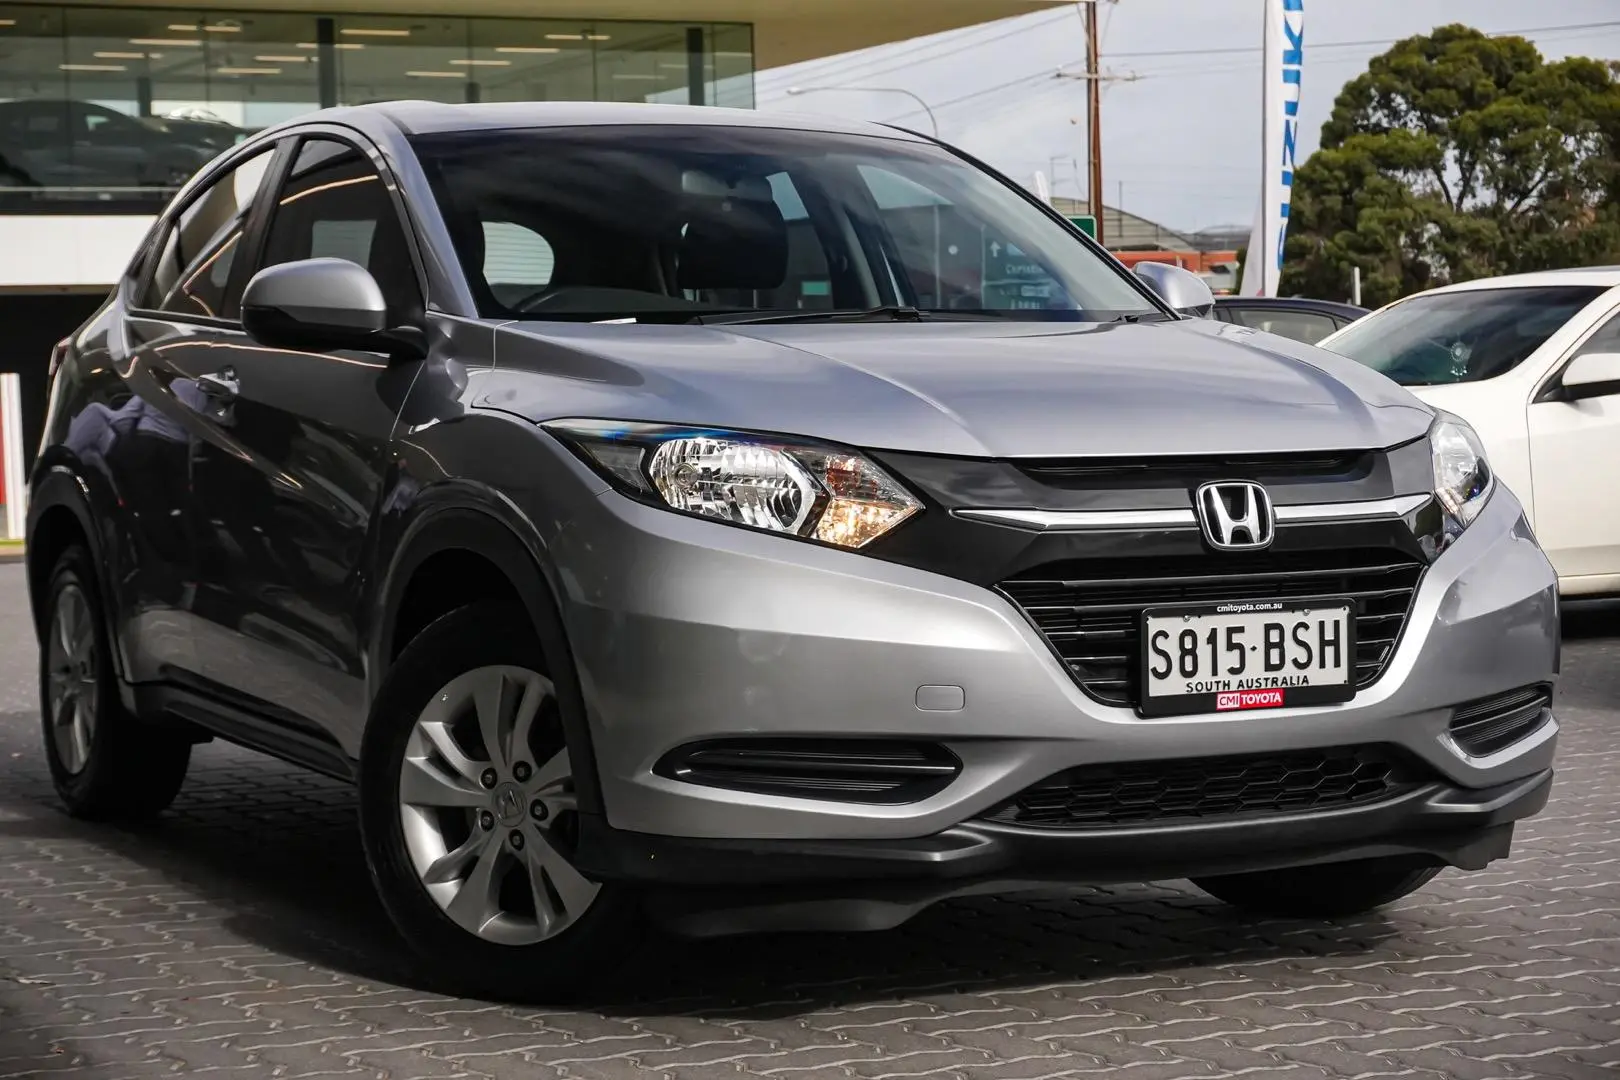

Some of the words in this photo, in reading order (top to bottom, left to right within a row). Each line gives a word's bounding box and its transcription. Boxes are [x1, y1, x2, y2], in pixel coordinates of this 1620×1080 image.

[1216, 602, 1283, 613] cmitoyota.com.au
[1186, 679, 1231, 693] SOUTH
[1236, 675, 1310, 690] AUSTRALIA
[1219, 695, 1239, 706] CMI
[1240, 692, 1281, 705] TOYOTA
